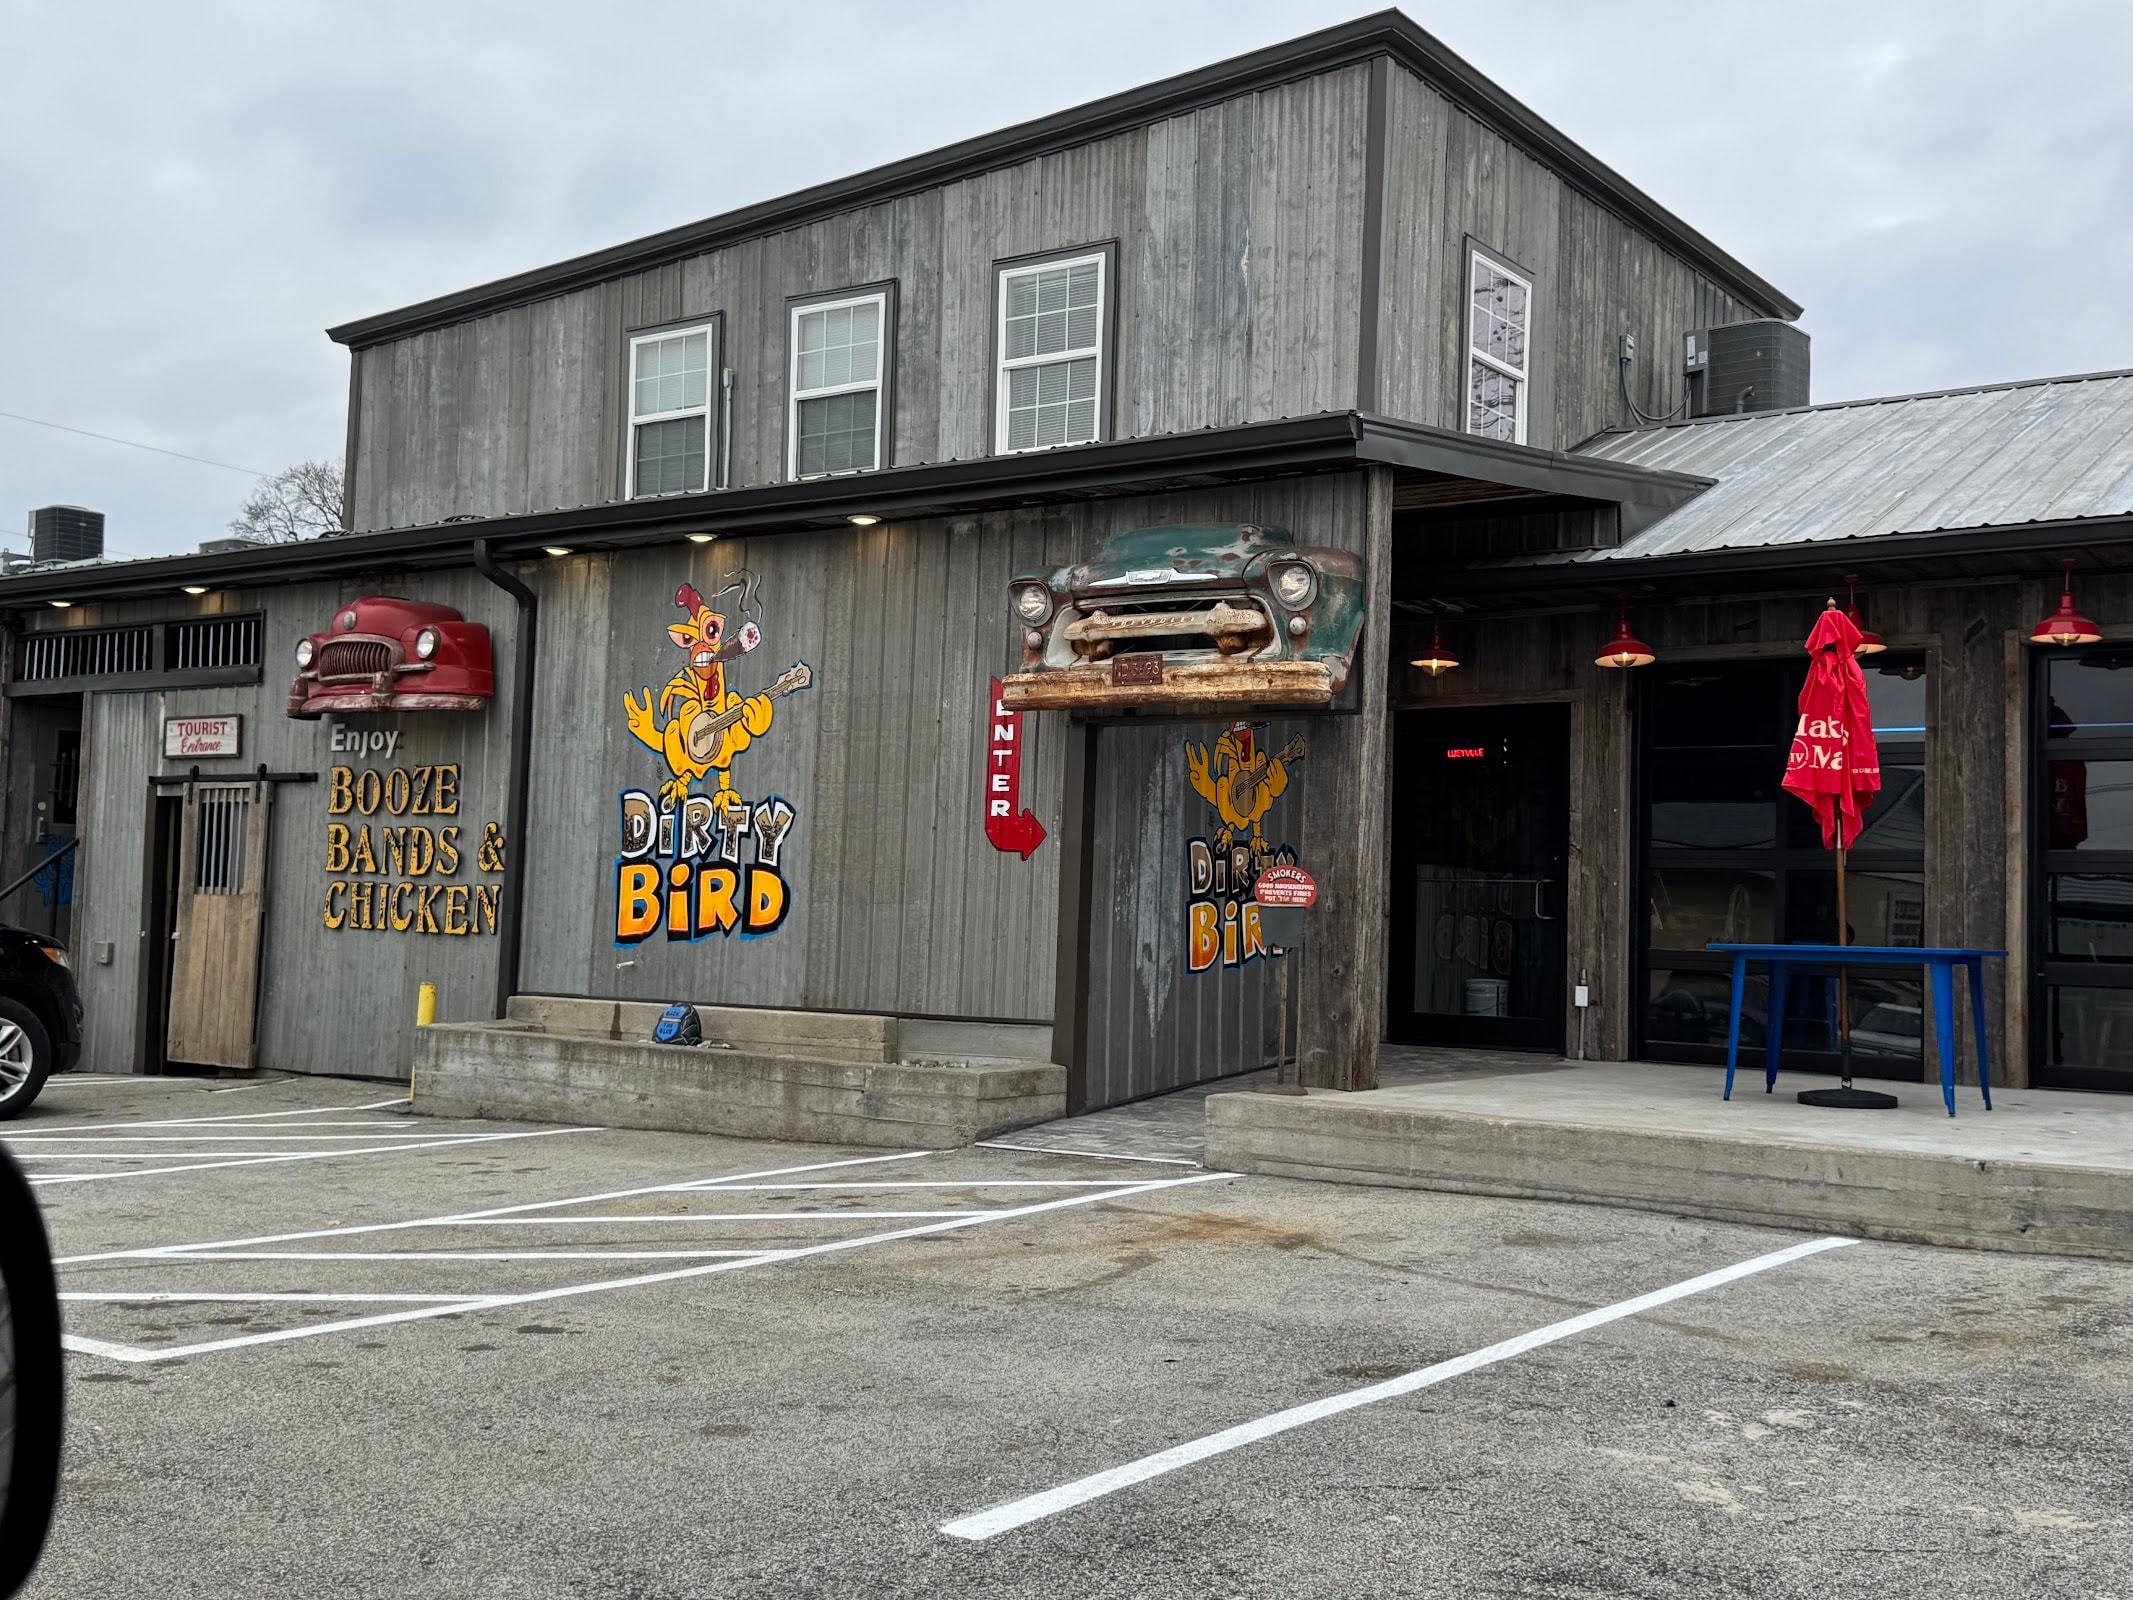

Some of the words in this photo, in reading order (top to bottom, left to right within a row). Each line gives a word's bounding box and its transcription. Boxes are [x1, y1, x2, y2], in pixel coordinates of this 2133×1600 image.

[177, 721, 228, 737] TOURIST
[180, 736, 222, 754] Entrance
[330, 723, 399, 759] Enjoy
[990, 699, 1015, 817] ENTER
[327, 764, 459, 815] BOOZE
[325, 823, 460, 877] BANDS
[477, 822, 505, 872] &
[1267, 869, 1306, 883] SMOKERS
[323, 881, 502, 936] CHICKEN
[1188, 899, 1285, 972] BiR
